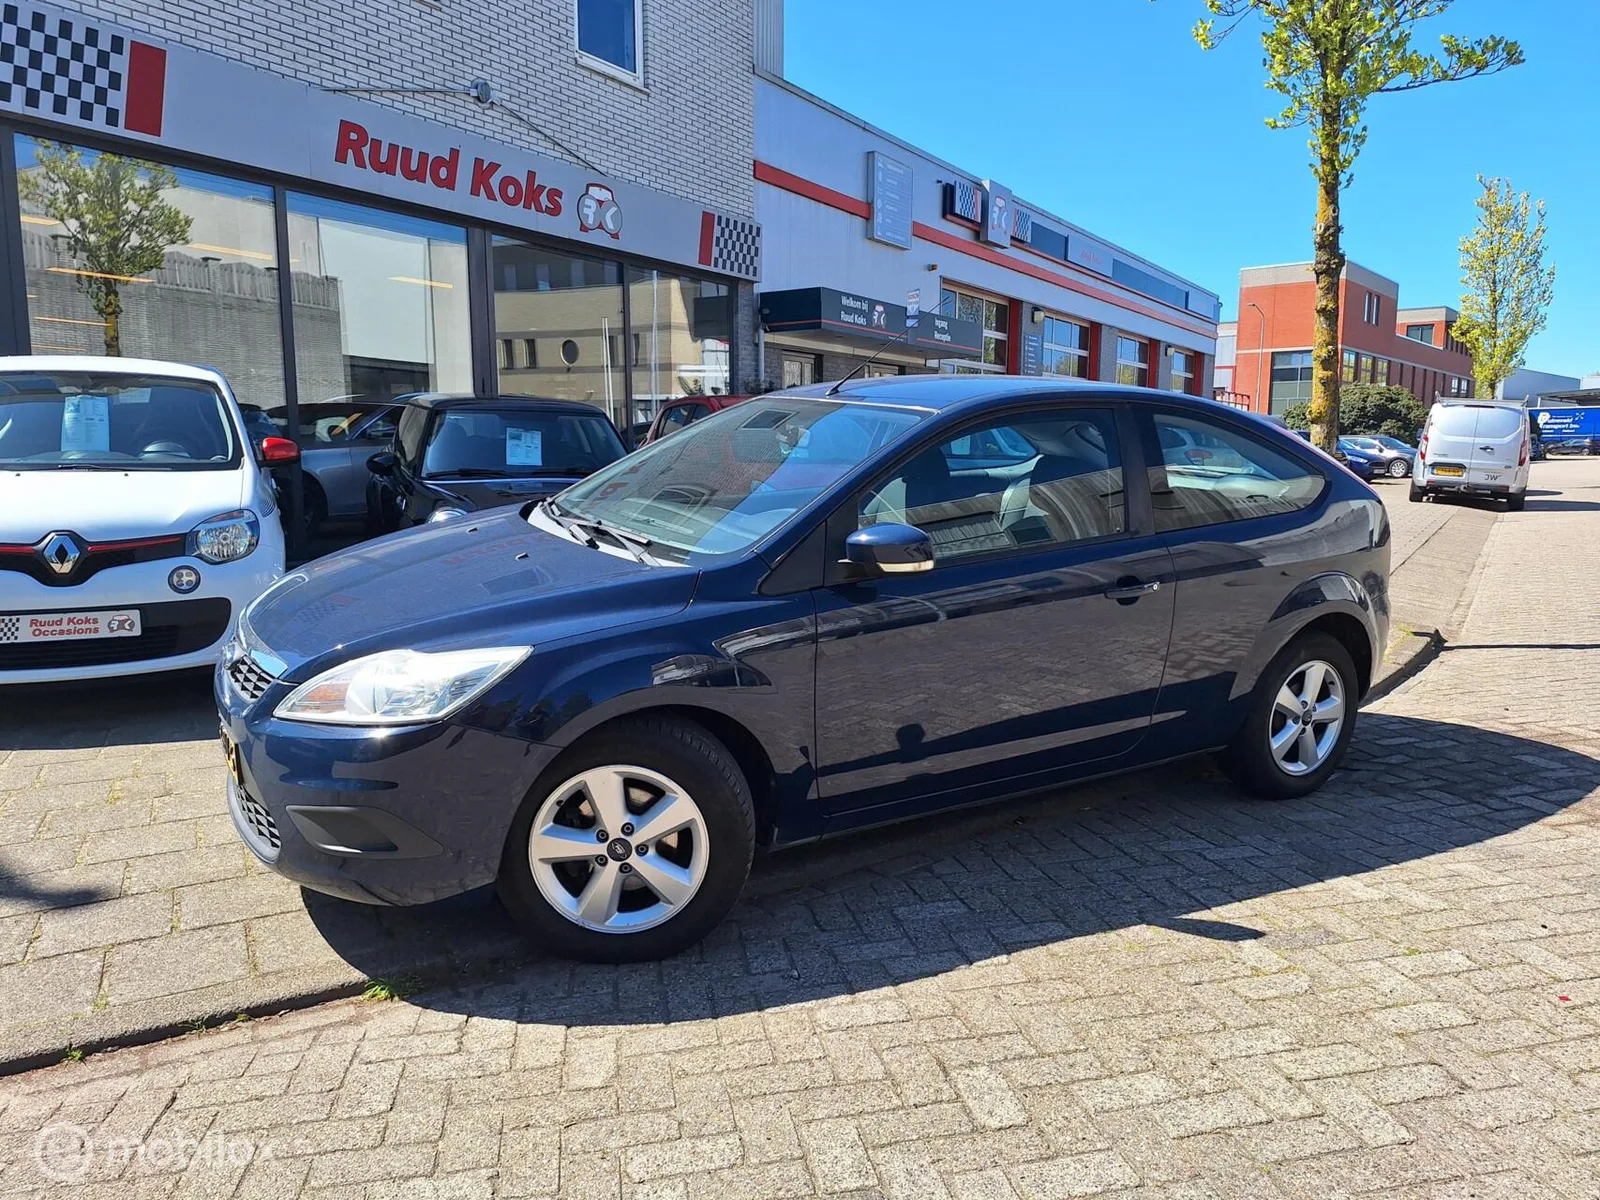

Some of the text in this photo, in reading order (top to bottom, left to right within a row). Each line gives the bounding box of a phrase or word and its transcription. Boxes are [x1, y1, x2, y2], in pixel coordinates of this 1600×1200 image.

[335, 119, 564, 217] Ruud Koks
[841, 295, 862, 310] Welkom
[840, 311, 867, 326] Ruud Koks
[934, 318, 949, 331] Ingang
[933, 330, 952, 343] Receptie
[29, 616, 99, 628] Ruud Koks
[31, 626, 100, 637] Occasions
